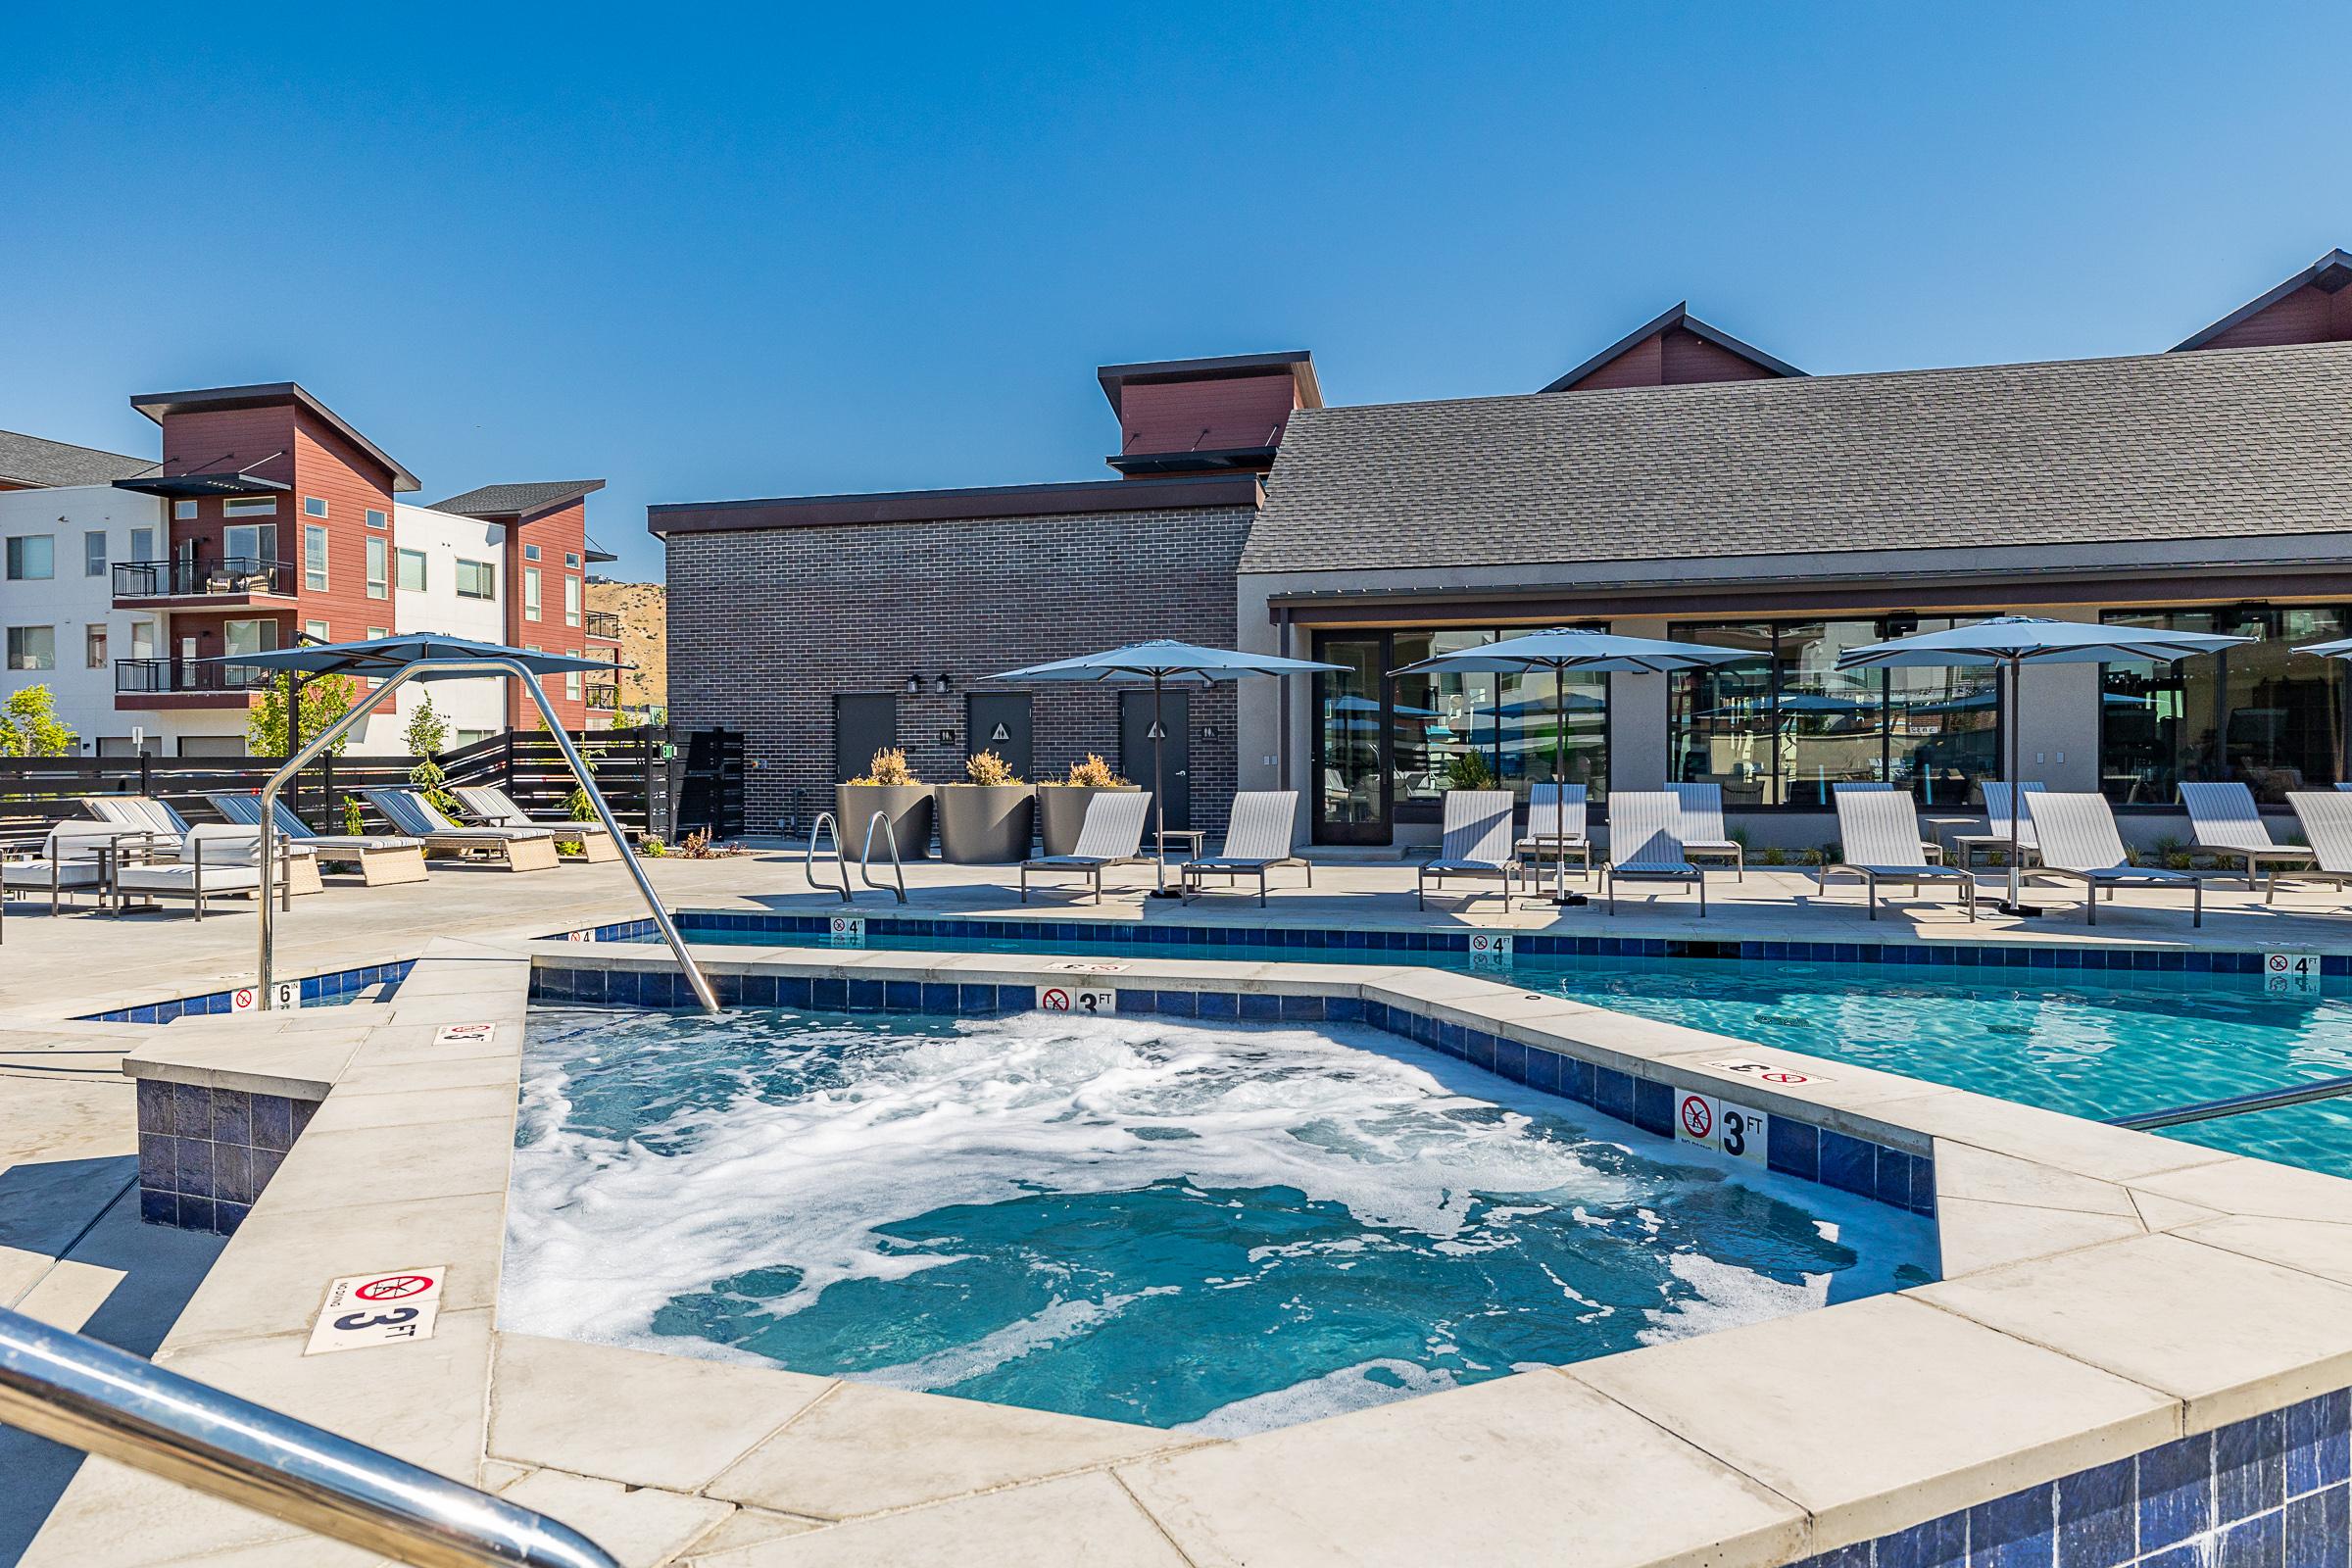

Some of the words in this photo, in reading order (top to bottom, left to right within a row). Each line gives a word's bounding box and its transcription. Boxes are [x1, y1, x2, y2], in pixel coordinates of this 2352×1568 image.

[849, 920, 858, 934] 4
[1493, 937, 1503, 953] 4
[2295, 956, 2308, 974] 4
[280, 984, 290, 1003] 6
[1079, 993, 1097, 1013] 3
[1099, 994, 1111, 1004] FT
[1723, 1111, 1744, 1155] 3
[1747, 1115, 1762, 1134] FT
[333, 1307, 419, 1331] 3
[385, 1324, 416, 1339] FT
